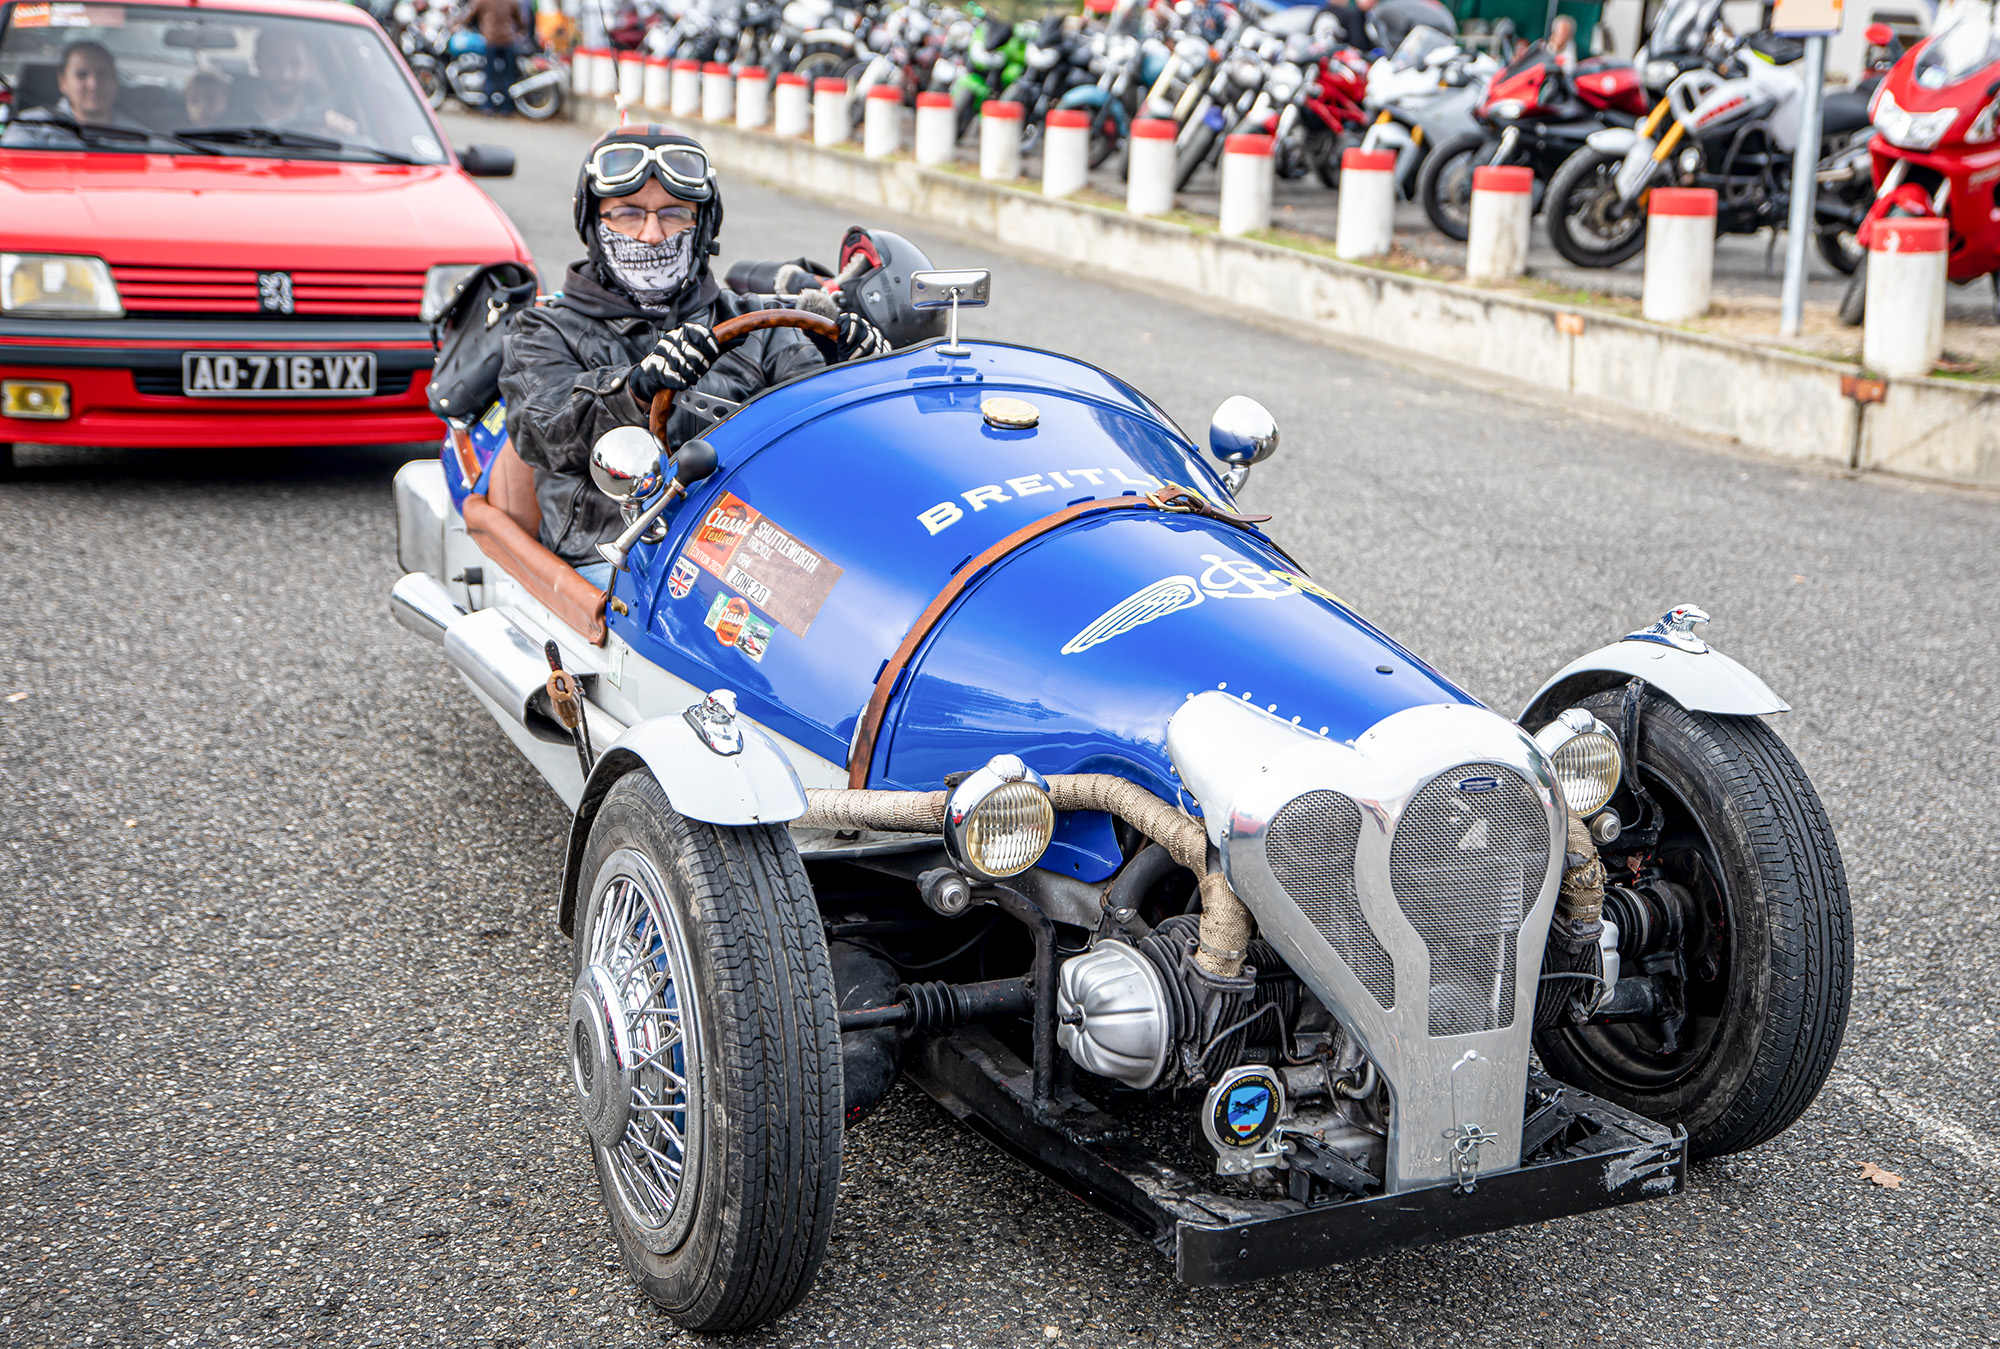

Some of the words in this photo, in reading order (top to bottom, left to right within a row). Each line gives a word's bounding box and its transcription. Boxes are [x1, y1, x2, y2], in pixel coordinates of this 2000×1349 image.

[705, 507, 754, 537] Classic
[704, 526, 738, 547] Festival
[746, 534, 775, 561] TRICYCLE
[754, 521, 821, 574] SHUTTLEWORTH
[677, 558, 698, 575] ENGLAND
[708, 559, 723, 575] 2021
[730, 569, 755, 595] ZONE
[719, 606, 750, 627] Classic
[1220, 1075, 1263, 1101] SHUTTLEWORTH
[1264, 1079, 1279, 1114] COLLECTION
[1224, 1134, 1236, 1145] OLD
[1238, 1134, 1261, 1146] WARDEN
